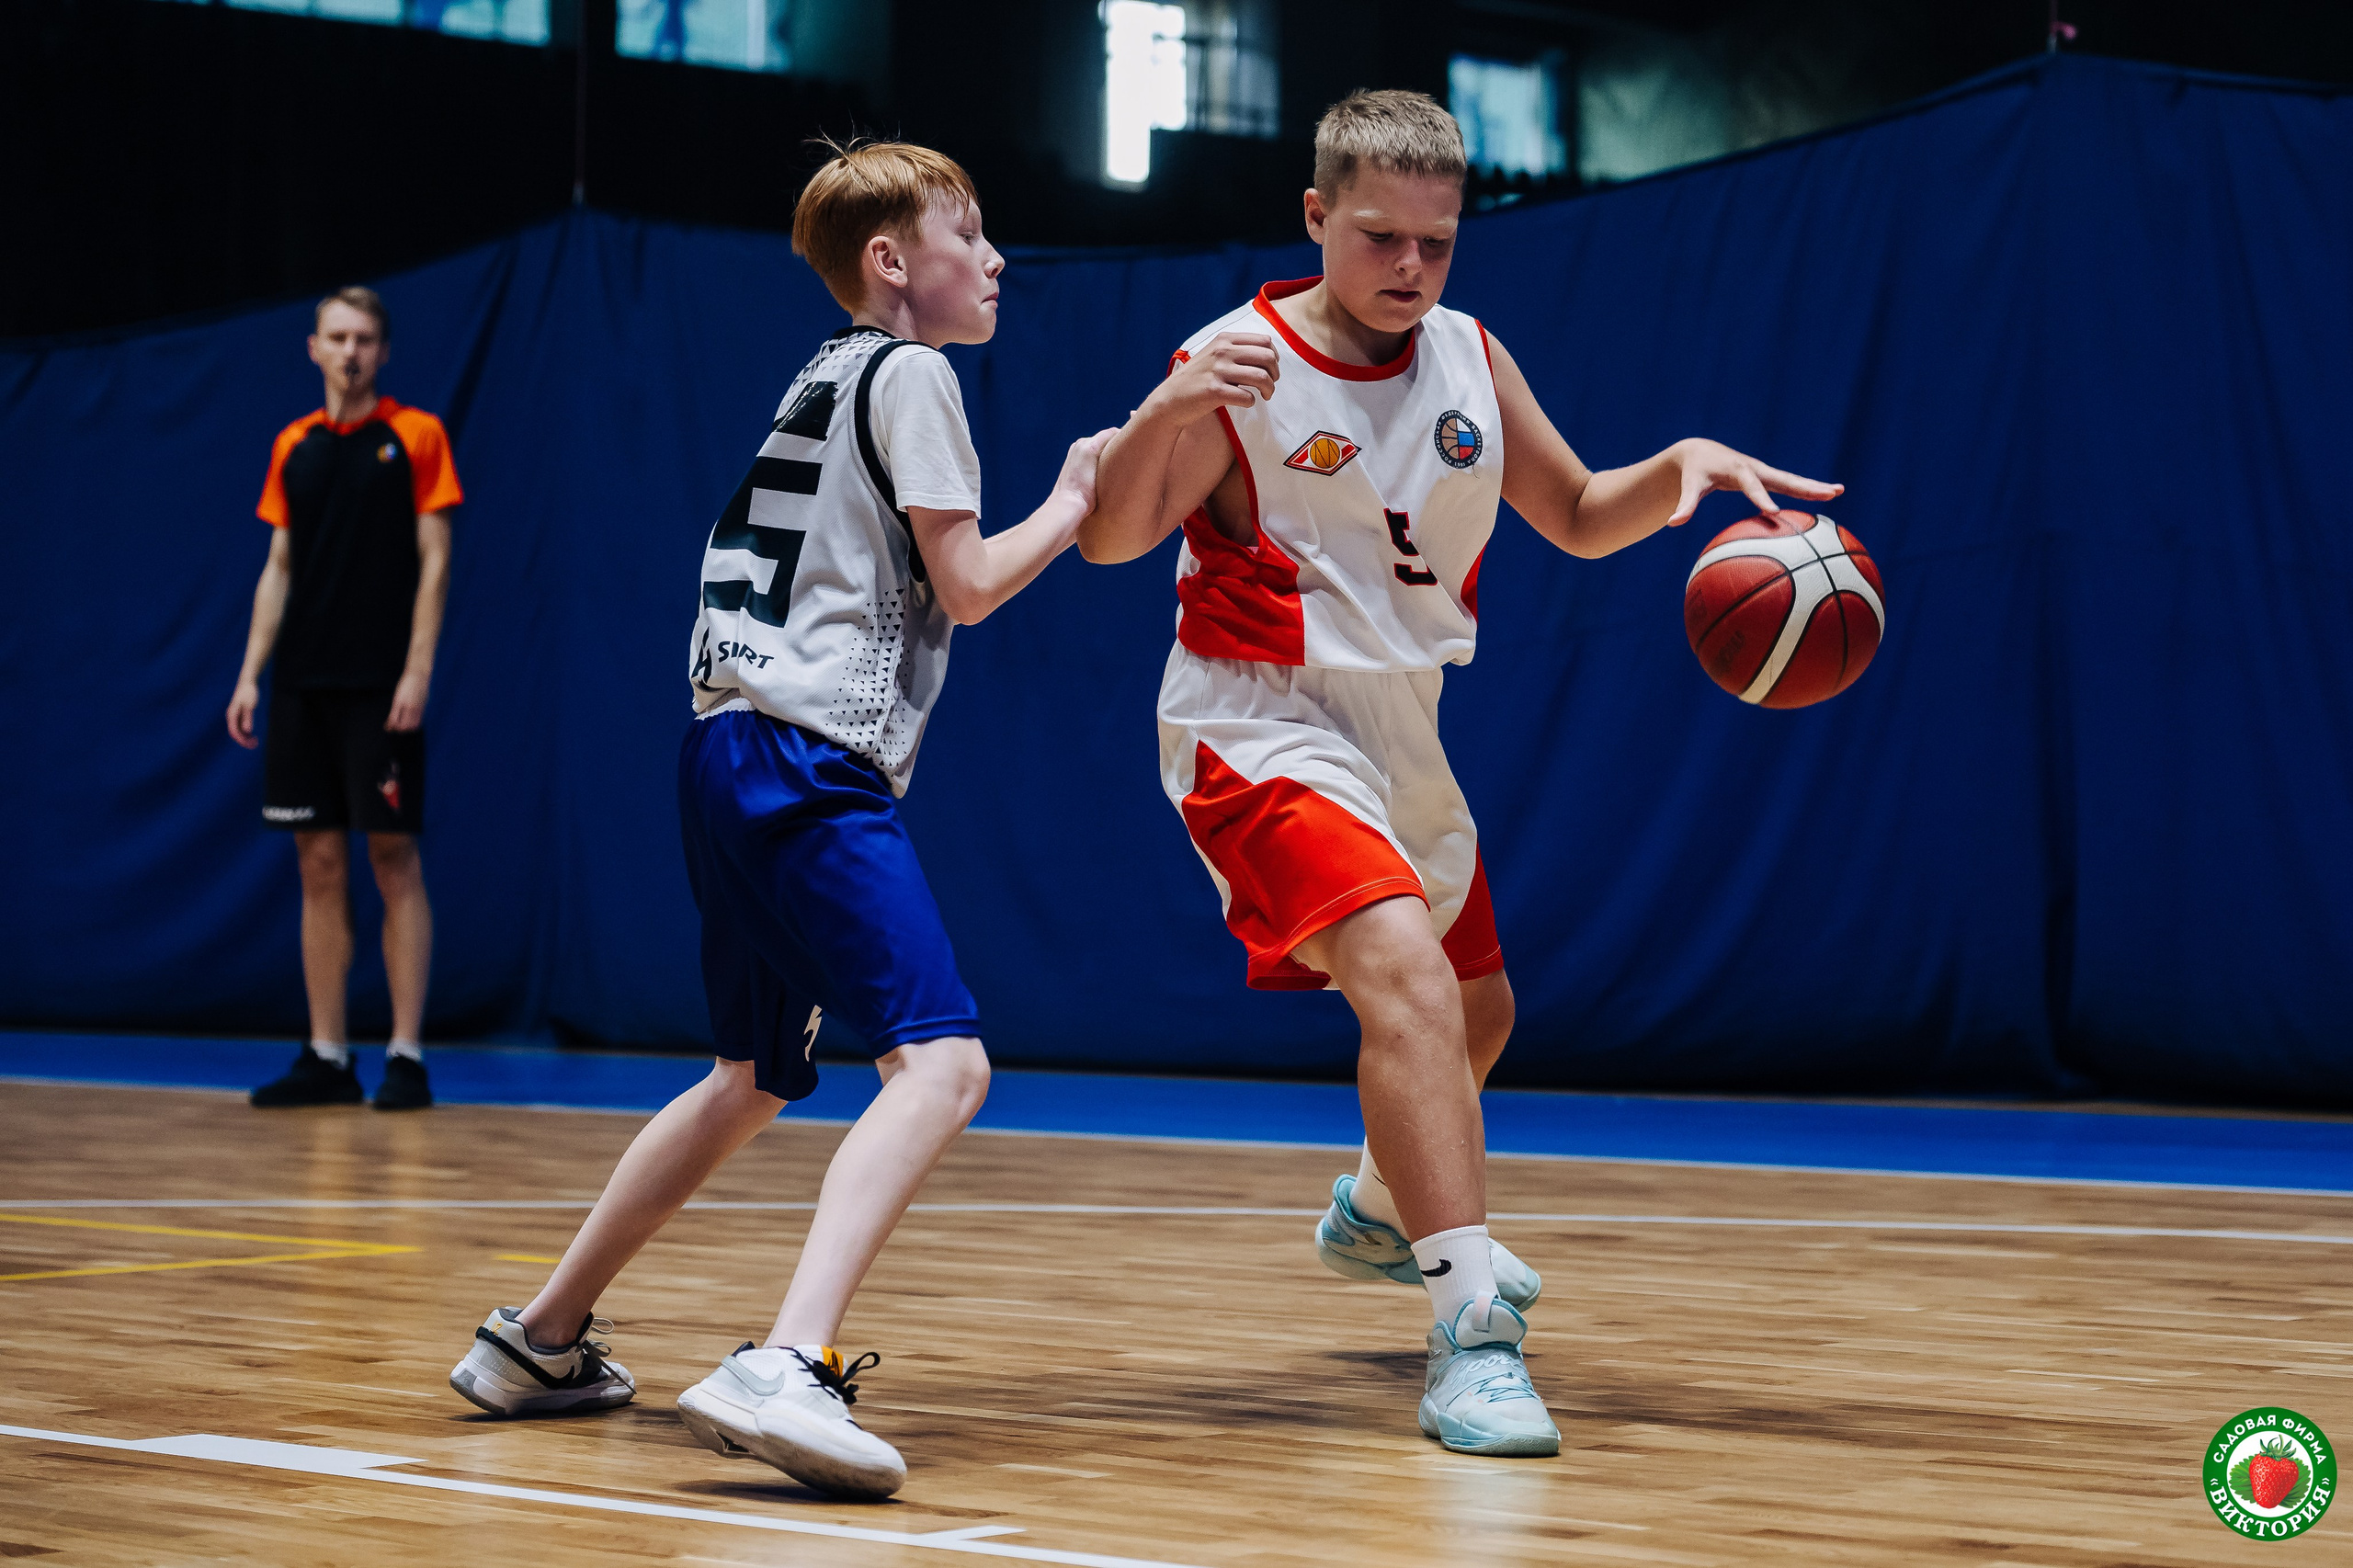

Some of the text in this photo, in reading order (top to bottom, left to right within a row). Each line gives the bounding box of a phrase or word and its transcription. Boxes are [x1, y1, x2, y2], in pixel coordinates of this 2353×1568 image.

[703, 456, 824, 629] 5
[1383, 507, 1438, 586] 5
[718, 641, 775, 669] SIRT
